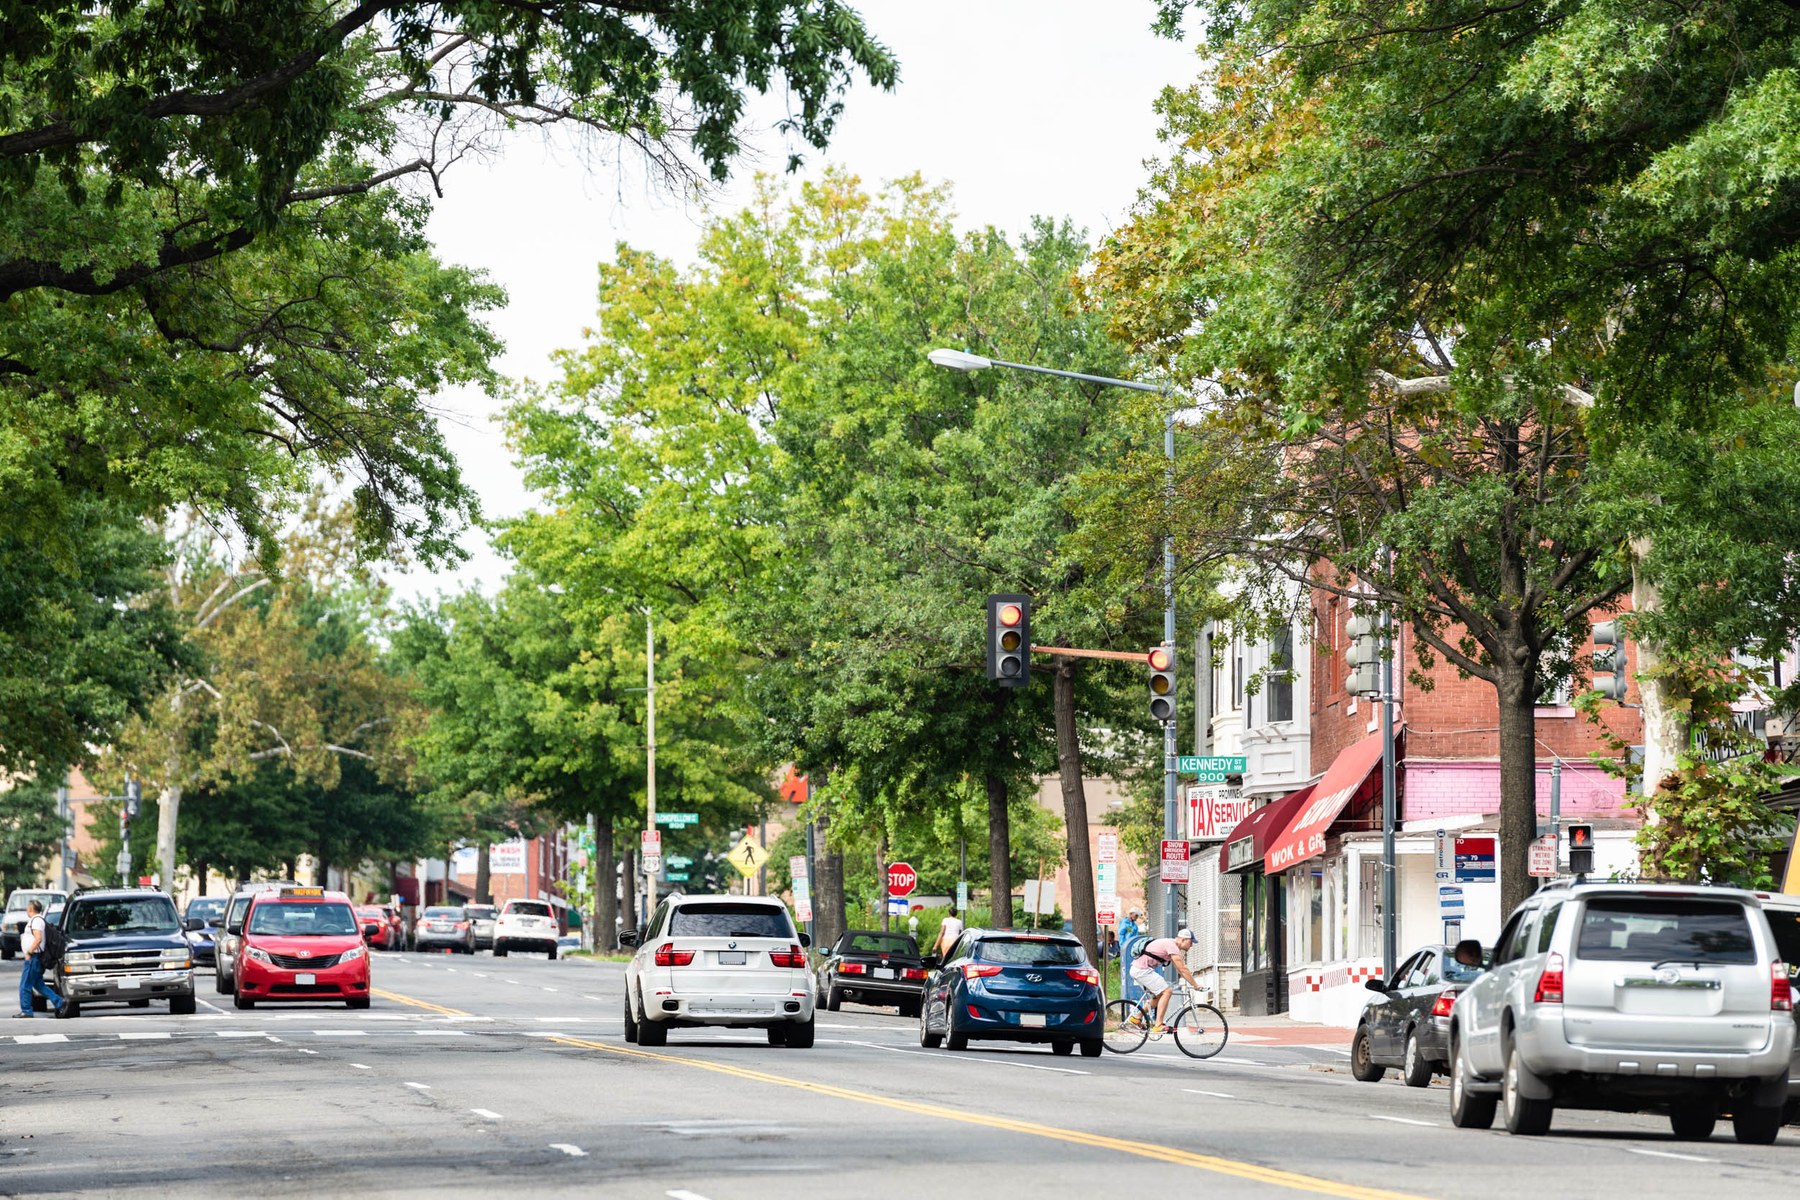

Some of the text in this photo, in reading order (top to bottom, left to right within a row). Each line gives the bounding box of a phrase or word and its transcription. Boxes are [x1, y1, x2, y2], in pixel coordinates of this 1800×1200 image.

[1182, 758, 1232, 770] KENNEDY
[1200, 772, 1224, 781] 900
[1218, 788, 1243, 799] PROMINEN
[1190, 798, 1252, 836] TAX SERVICE
[1272, 844, 1294, 868] WOK
[1298, 840, 1304, 856] &
[888, 873, 914, 886] STOP
